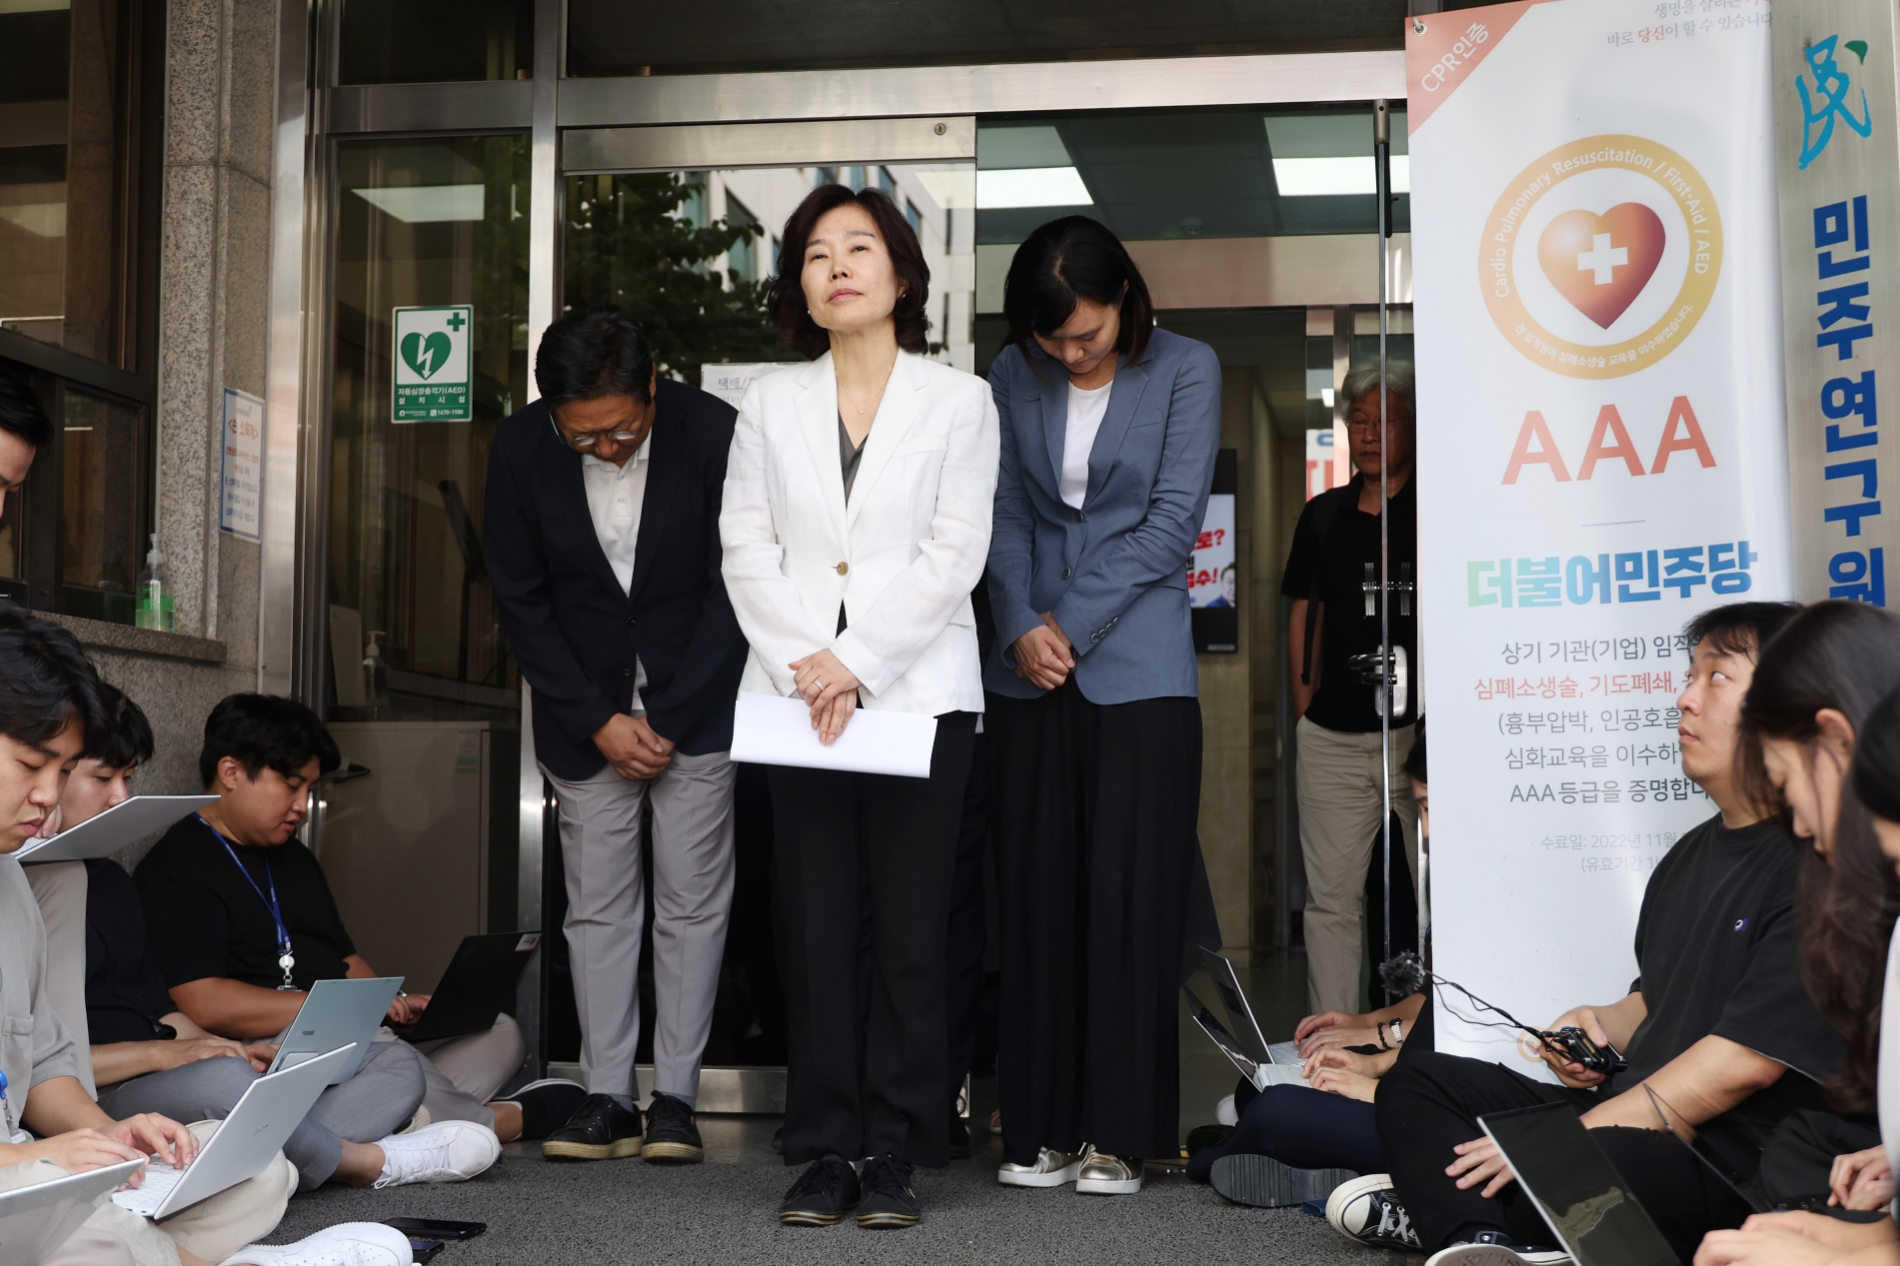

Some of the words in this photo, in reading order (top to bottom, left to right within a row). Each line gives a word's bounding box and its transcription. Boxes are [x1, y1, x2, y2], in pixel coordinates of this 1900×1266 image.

[1653, 0, 1696, 19] 생명을
[1607, 31, 1635, 47] 바로
[1637, 22, 1678, 44] 당신이
[1682, 20, 1697, 36] 할
[1699, 18, 1715, 33] 수
[1421, 22, 1489, 92] CPR인증
[1552, 147, 1654, 176] Resuscitation
[1494, 170, 1552, 243] Pulmonary
[1662, 165, 1708, 226] First-Aid
[1695, 239, 1711, 275] AED
[1491, 247, 1510, 298] Cardio
[1501, 395, 1717, 486] AAA
[1466, 540, 1758, 609] 더불어민주당
[1501, 641, 1542, 665] 상기
[1549, 636, 1647, 663] 기관(기업)
[1653, 634, 1699, 659] 임직
[1474, 675, 1584, 700] 심폐소생술,
[1589, 671, 1678, 696] 기도폐쇄,
[1498, 710, 1594, 735] (흉부압박,
[1504, 744, 1610, 770] 심화교육을
[1616, 742, 1684, 767] 이수하
[1509, 780, 1622, 805] AAA등급을
[1540, 833, 1588, 850] 수료일:
[1590, 832, 1642, 849] 2022년
[1645, 831, 1677, 846] 11월
[1581, 855, 1643, 873] (유효기간
